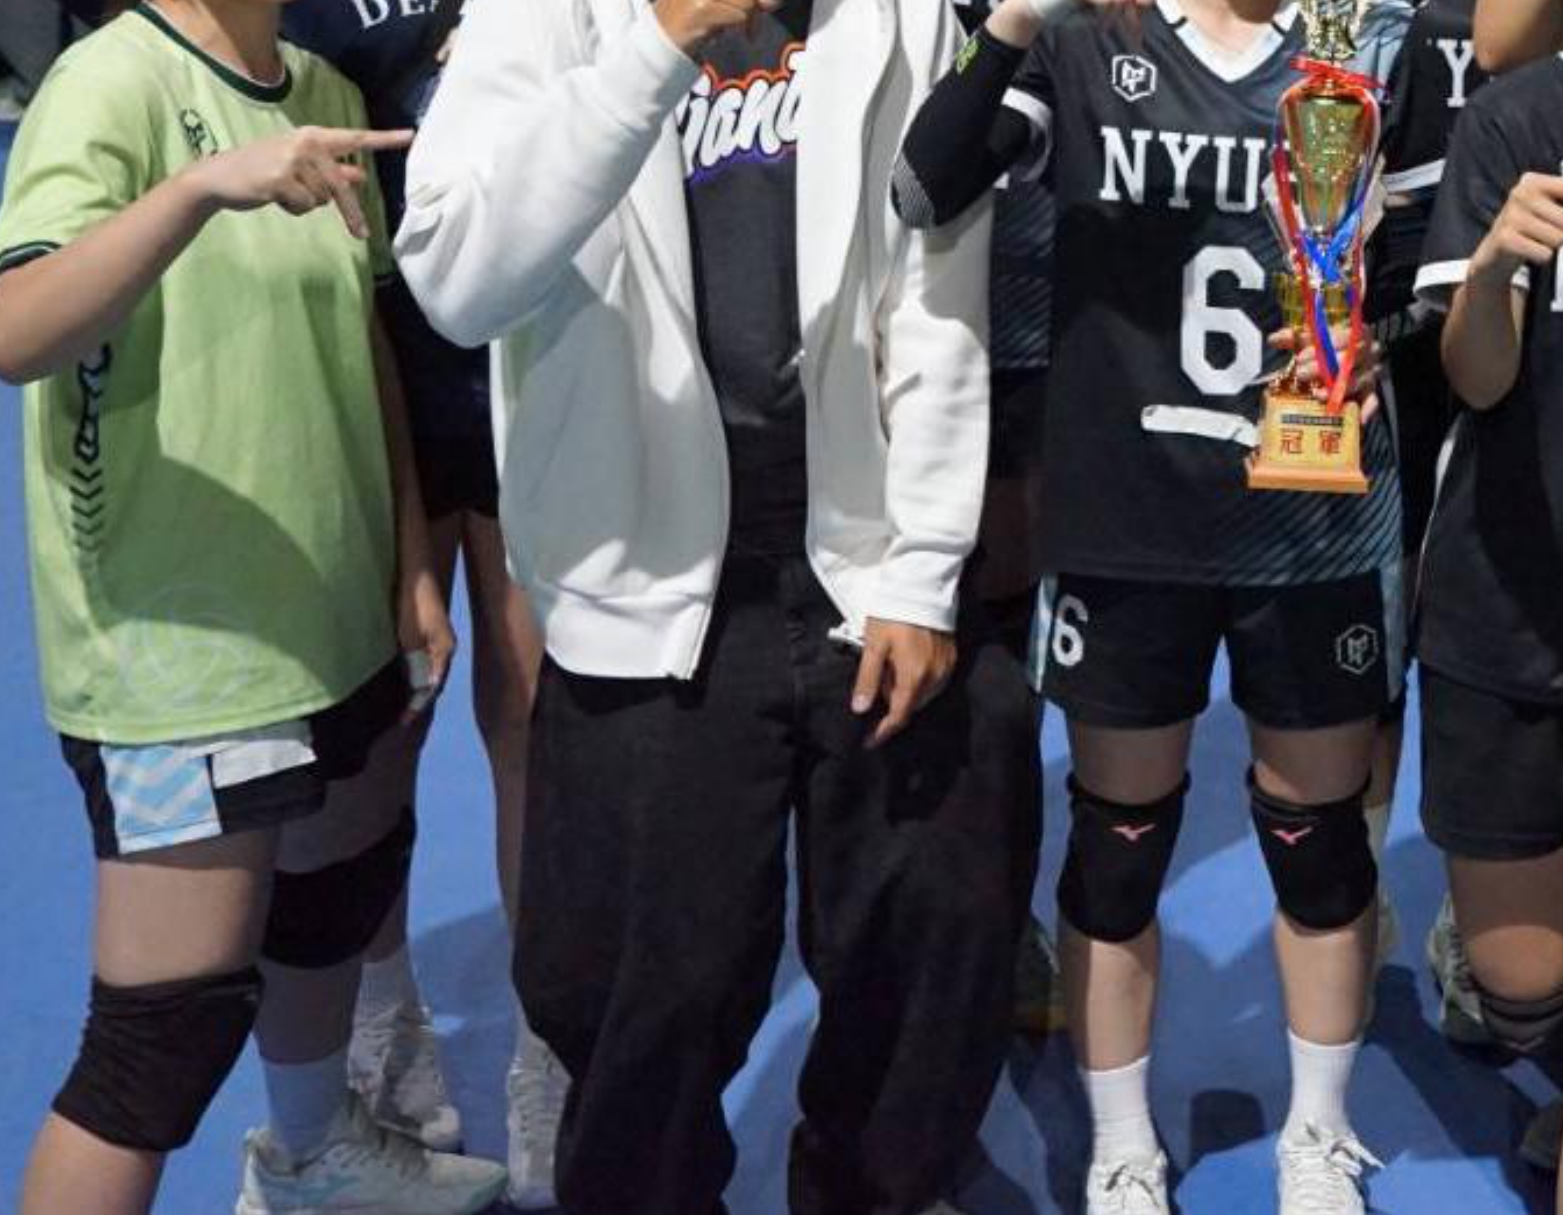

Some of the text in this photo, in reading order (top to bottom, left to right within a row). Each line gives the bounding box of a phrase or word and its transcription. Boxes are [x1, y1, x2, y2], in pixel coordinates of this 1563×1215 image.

[1098, 125, 1266, 213] NYU
[1180, 246, 1266, 397] 6
[1052, 594, 1089, 668] 6
